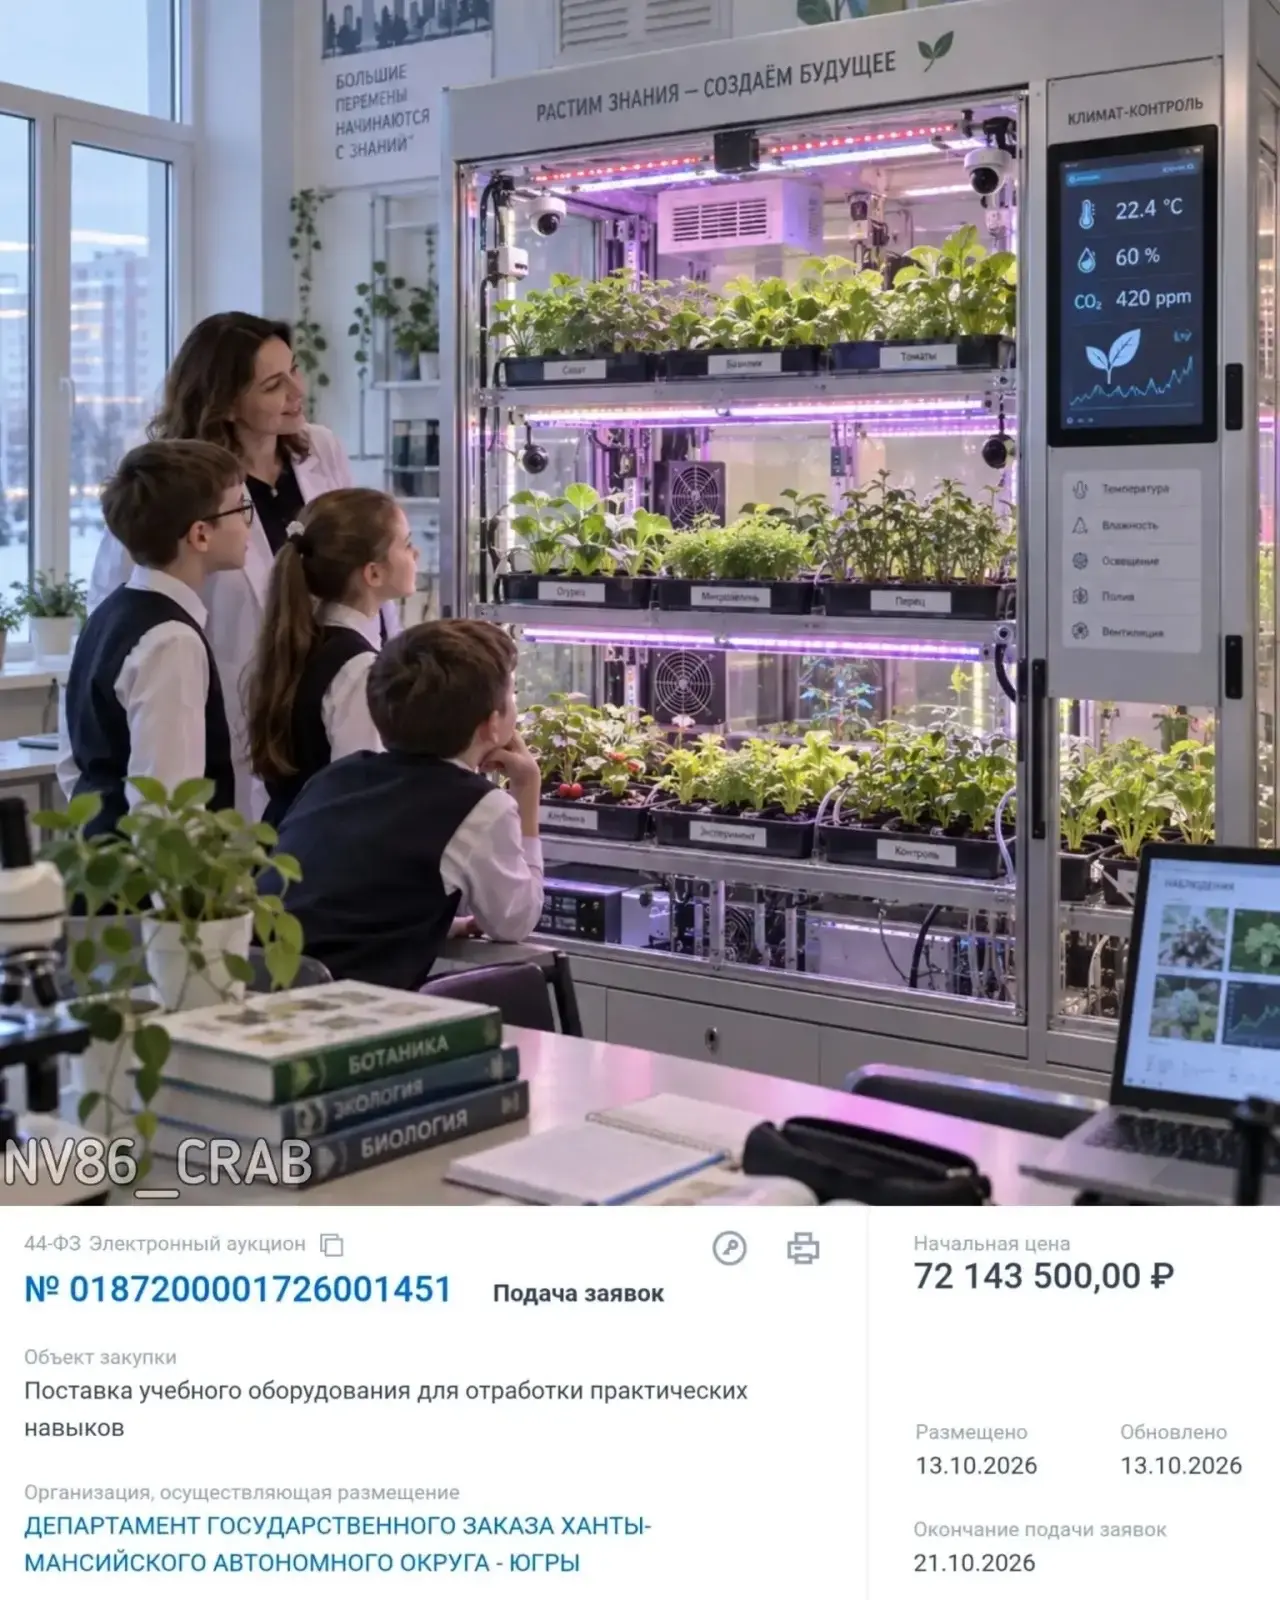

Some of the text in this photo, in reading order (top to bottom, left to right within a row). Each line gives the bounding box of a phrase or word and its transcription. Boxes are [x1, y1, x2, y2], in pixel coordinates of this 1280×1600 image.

[336, 63, 408, 90] БОЛЬШИЕ
[537, 95, 603, 122] РАСТИМ
[608, 83, 680, 112] ЗНАНИЯ
[704, 64, 793, 98] СОЗДАЁМ
[800, 50, 897, 85] БУДУЩЕЕ
[335, 87, 409, 113] ПЕРЕМЕНЫ
[1067, 97, 1205, 126] КЛИМАТ-КОНТРОЛЬ
[335, 108, 431, 136] НАЧИНАЮТСЯ
[335, 145, 345, 160] С
[1116, 198, 1184, 221] 22.4 °C
[1116, 247, 1161, 267] 60 %
[1116, 288, 1151, 308] 420
[1155, 290, 1192, 309] ppm
[1102, 483, 1170, 495] Температура
[1102, 520, 1159, 531] Влажность
[1102, 556, 1160, 567] Освещение
[1102, 591, 1135, 602] Полив
[1102, 626, 1165, 639] Вентиляция
[348, 1034, 450, 1076] БОТАНИКА
[333, 1078, 424, 1121] ЭКОЛОГИЯ
[360, 1108, 468, 1159] БИОЛОГИЯ
